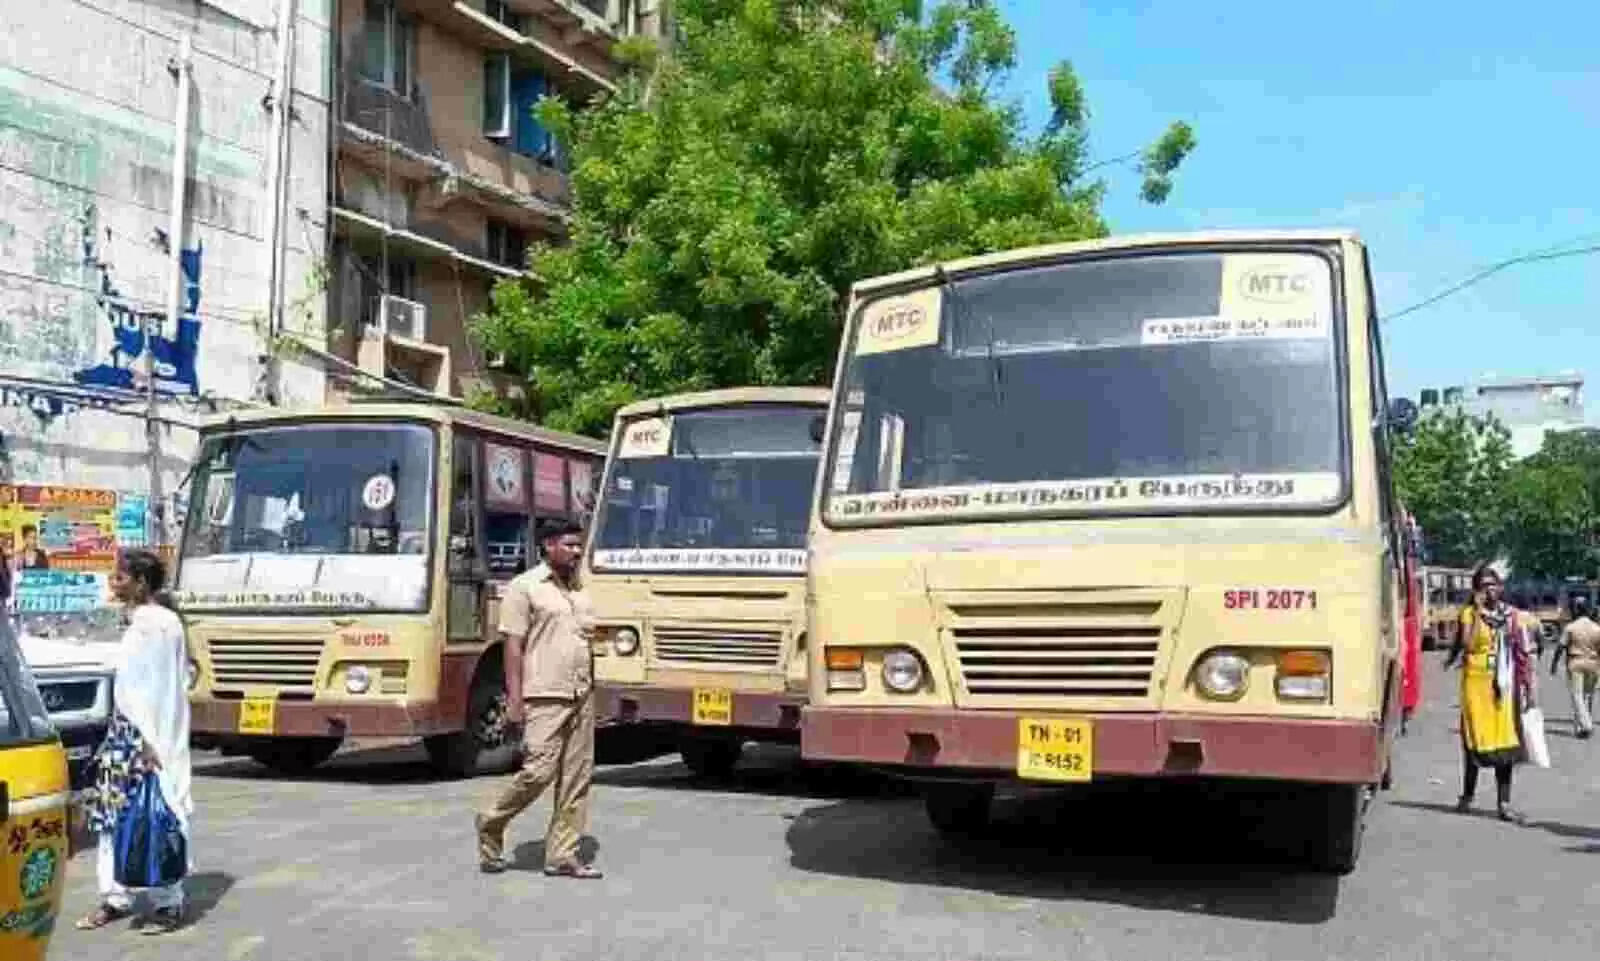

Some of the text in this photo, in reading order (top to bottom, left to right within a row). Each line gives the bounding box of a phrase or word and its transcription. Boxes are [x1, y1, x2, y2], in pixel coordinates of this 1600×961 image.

[1249, 273, 1306, 294] MTC
[878, 308, 921, 333] MTC
[632, 429, 661, 445] MTC
[1223, 589, 1318, 610] SPI 2071
